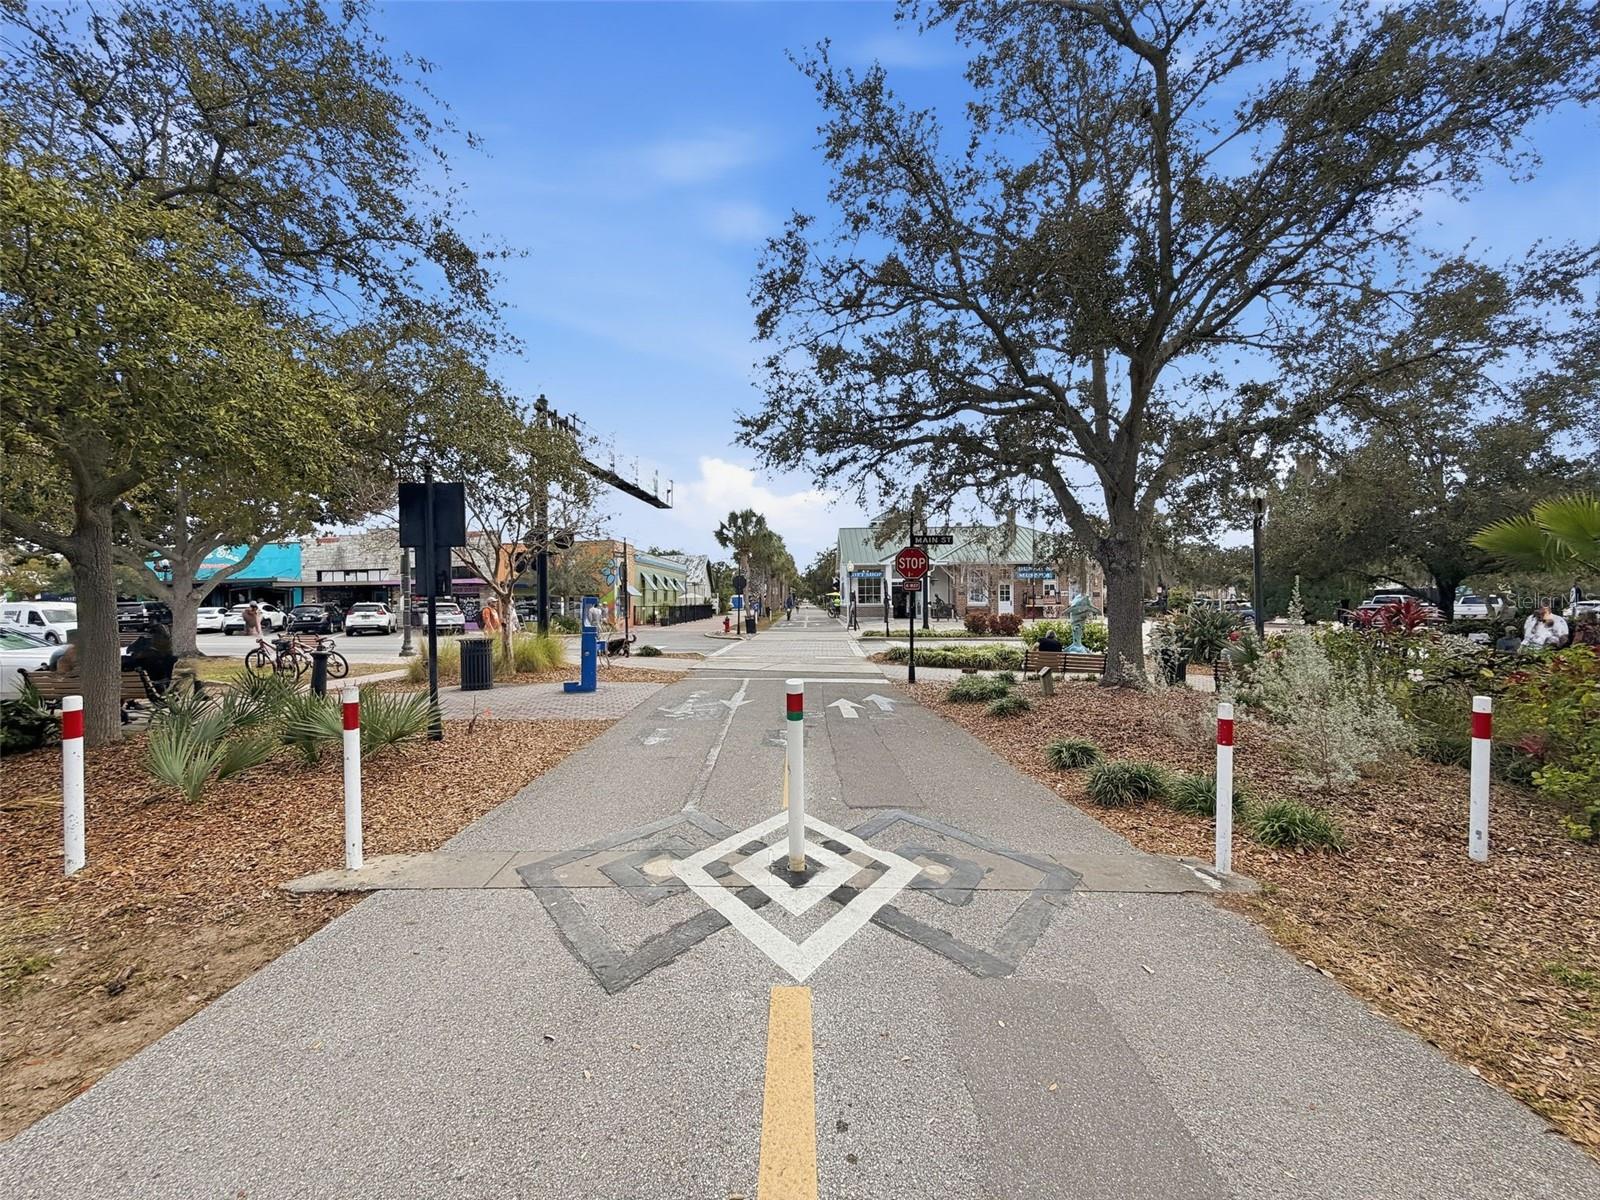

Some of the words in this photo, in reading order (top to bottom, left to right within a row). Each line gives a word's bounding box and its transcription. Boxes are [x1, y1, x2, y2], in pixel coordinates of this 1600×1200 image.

[915, 536, 938, 544] MAIN
[940, 536, 952, 544] ST
[898, 557, 926, 569] STOP
